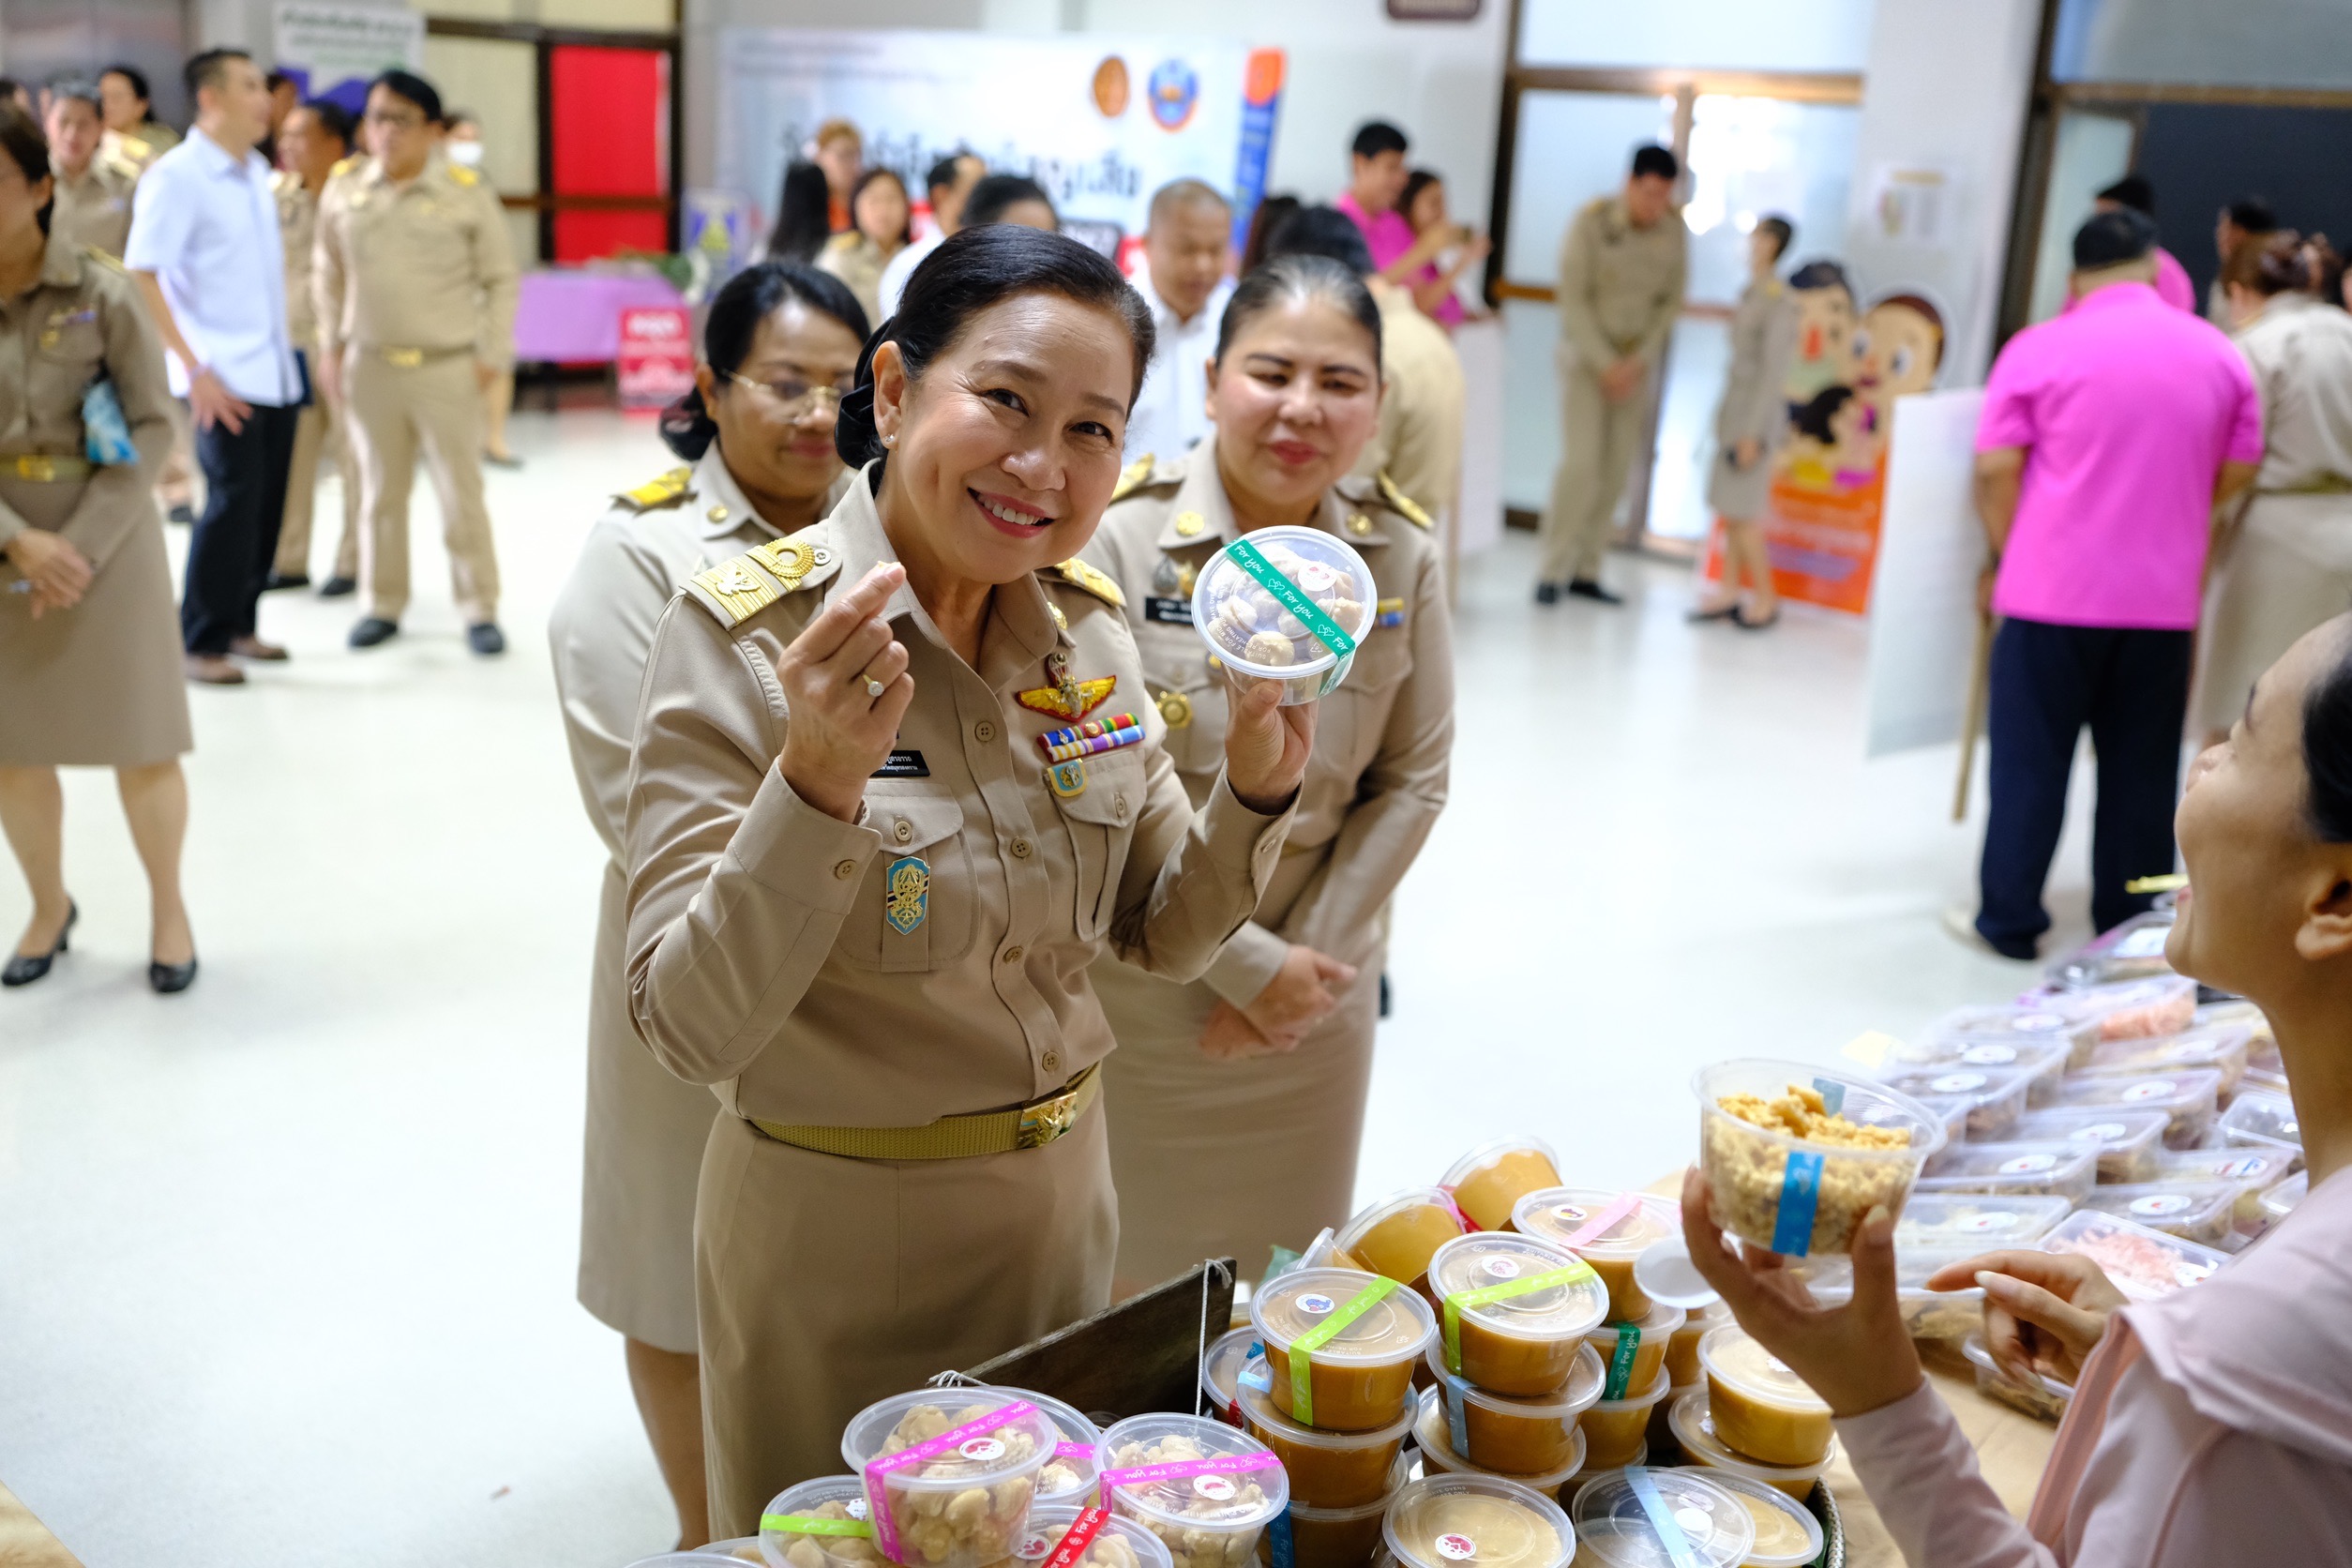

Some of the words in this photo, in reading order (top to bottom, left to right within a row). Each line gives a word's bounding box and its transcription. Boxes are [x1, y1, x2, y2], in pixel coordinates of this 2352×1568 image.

[1234, 545, 1250, 559] For
[1244, 558, 1264, 574] you
[1282, 590, 1300, 606] For
[1293, 603, 1313, 620] you
[1333, 636, 1349, 651] For
[1621, 1350, 1631, 1364] For
[1626, 1331, 1637, 1349] you
[945, 1429, 966, 1443] you
[875, 1457, 898, 1470] you
[900, 1451, 918, 1463] For
[1196, 1461, 1217, 1471] you
[1124, 1469, 1147, 1481] you
[1149, 1469, 1166, 1478] For
[1057, 1547, 1071, 1564] you
[1075, 1521, 1089, 1534] For
[1085, 1507, 1101, 1524] you
